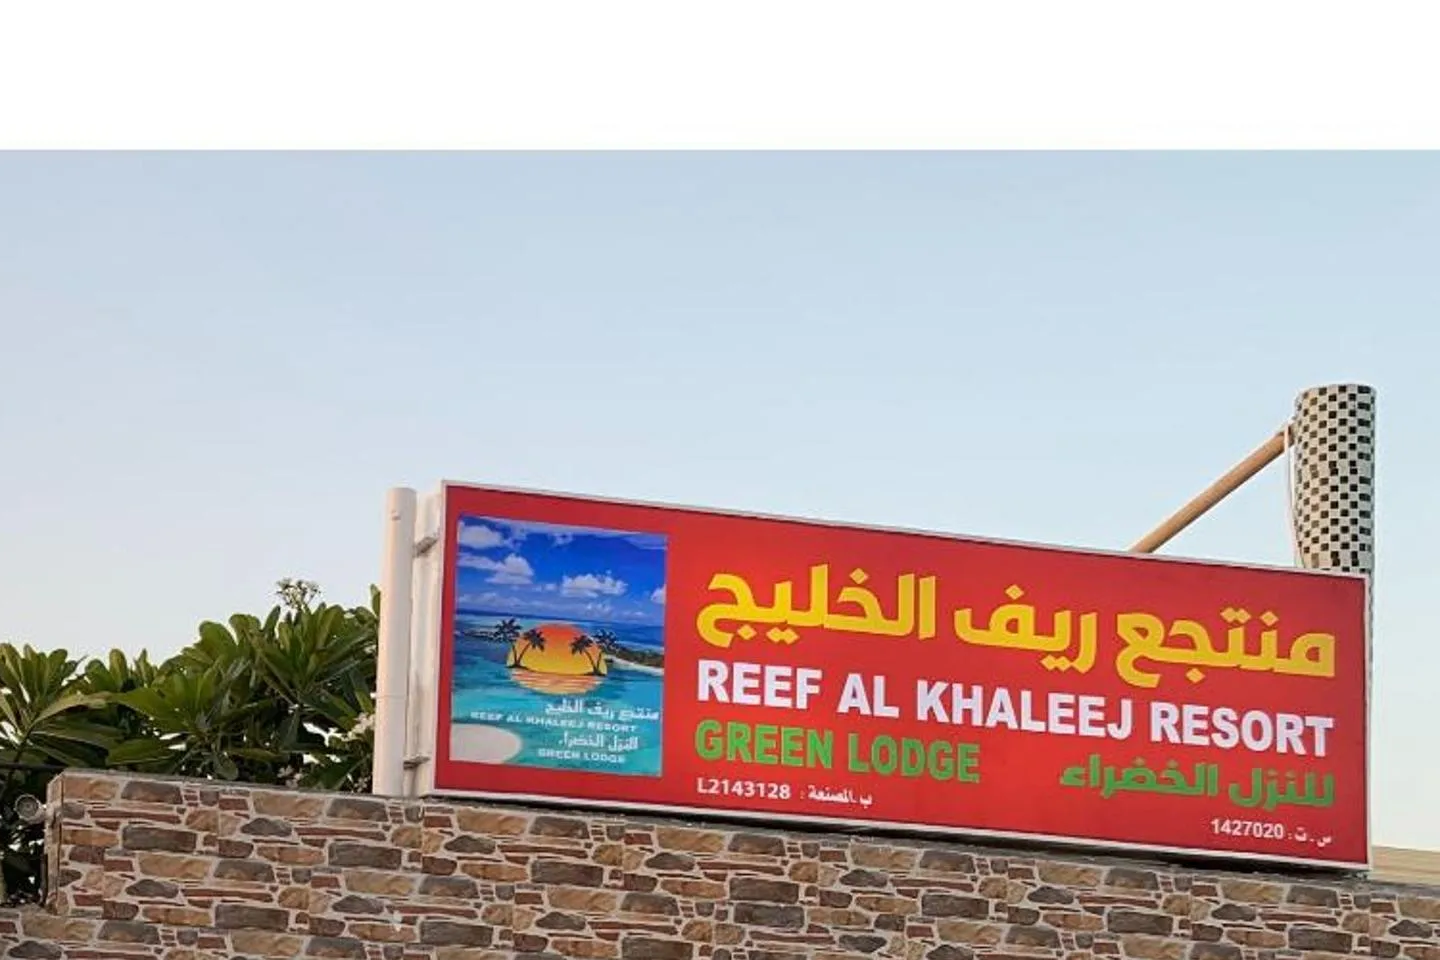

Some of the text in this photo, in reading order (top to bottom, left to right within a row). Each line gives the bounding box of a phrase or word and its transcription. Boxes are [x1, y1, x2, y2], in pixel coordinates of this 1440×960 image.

[696, 563, 1336, 689] منتجع ريف الخليج
[470, 711, 638, 733] REEF AL KHALEEJ RESORT
[697, 659, 1335, 757] REEF AL KHALEEJ RESORT
[537, 748, 627, 763] GREEN LODGE
[694, 719, 981, 783] GREEN LODGE
[697, 777, 791, 800] L2143128
[1060, 753, 1336, 812] للنزل الخضراء
[1211, 818, 1285, 840] 1427020
